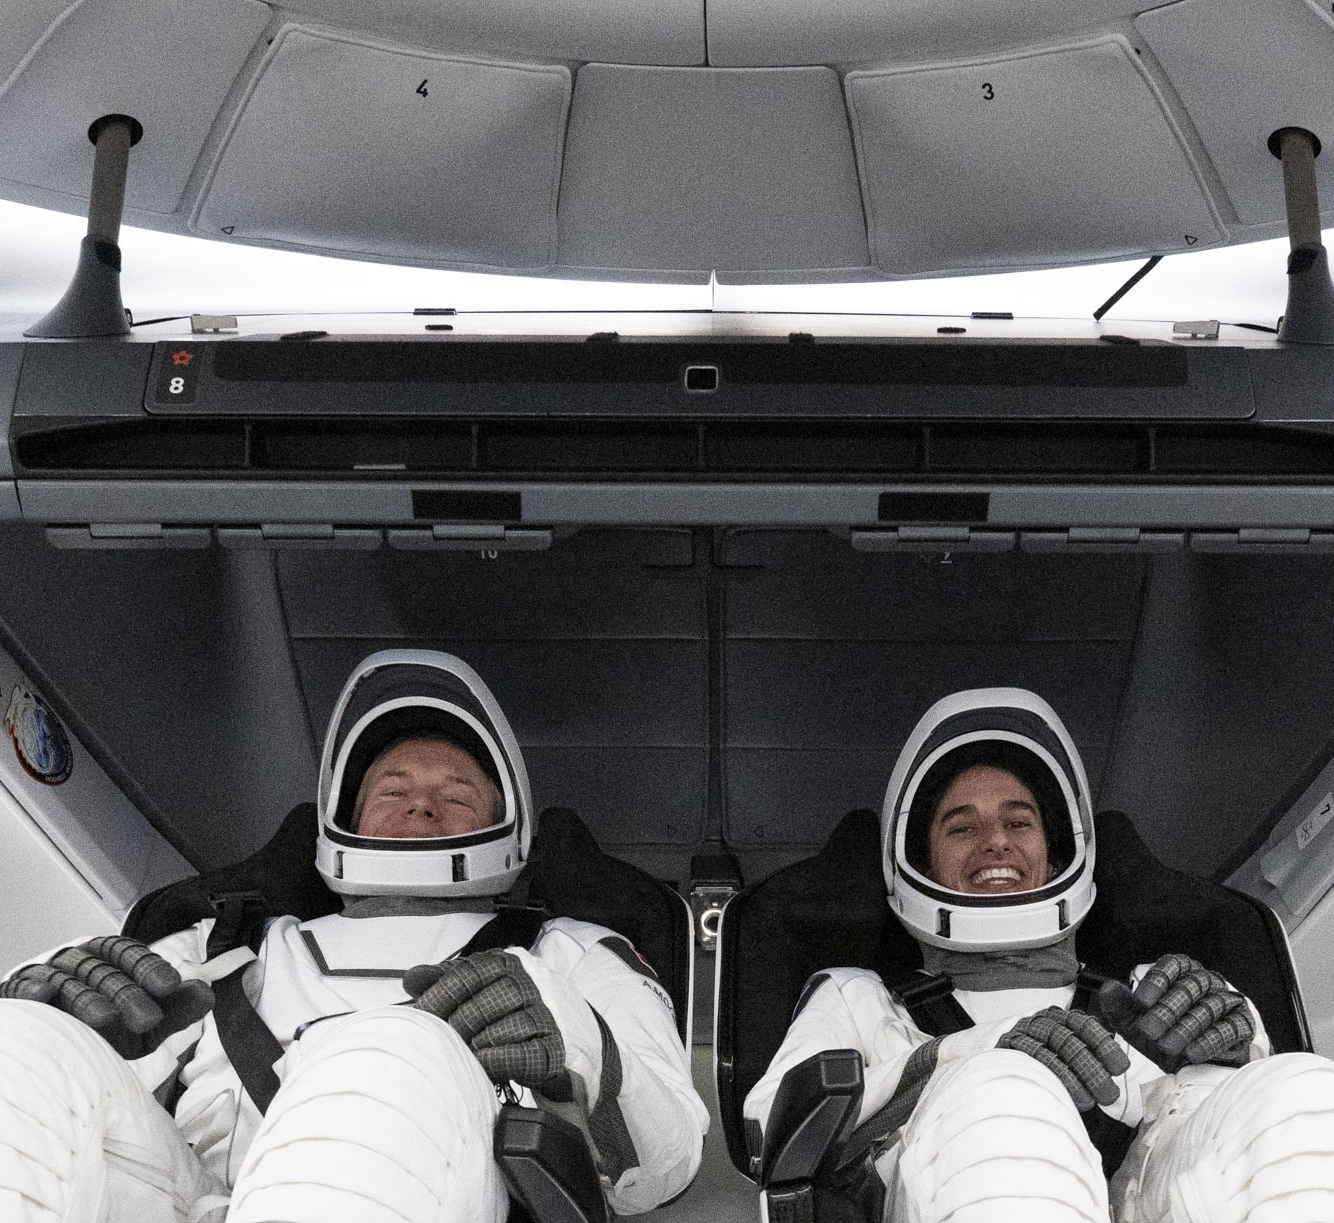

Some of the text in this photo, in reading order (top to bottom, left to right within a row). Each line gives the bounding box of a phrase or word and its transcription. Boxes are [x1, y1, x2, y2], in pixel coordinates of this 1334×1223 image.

[416, 79, 429, 98] 4
[981, 82, 995, 100] 3
[169, 377, 185, 394] 8
